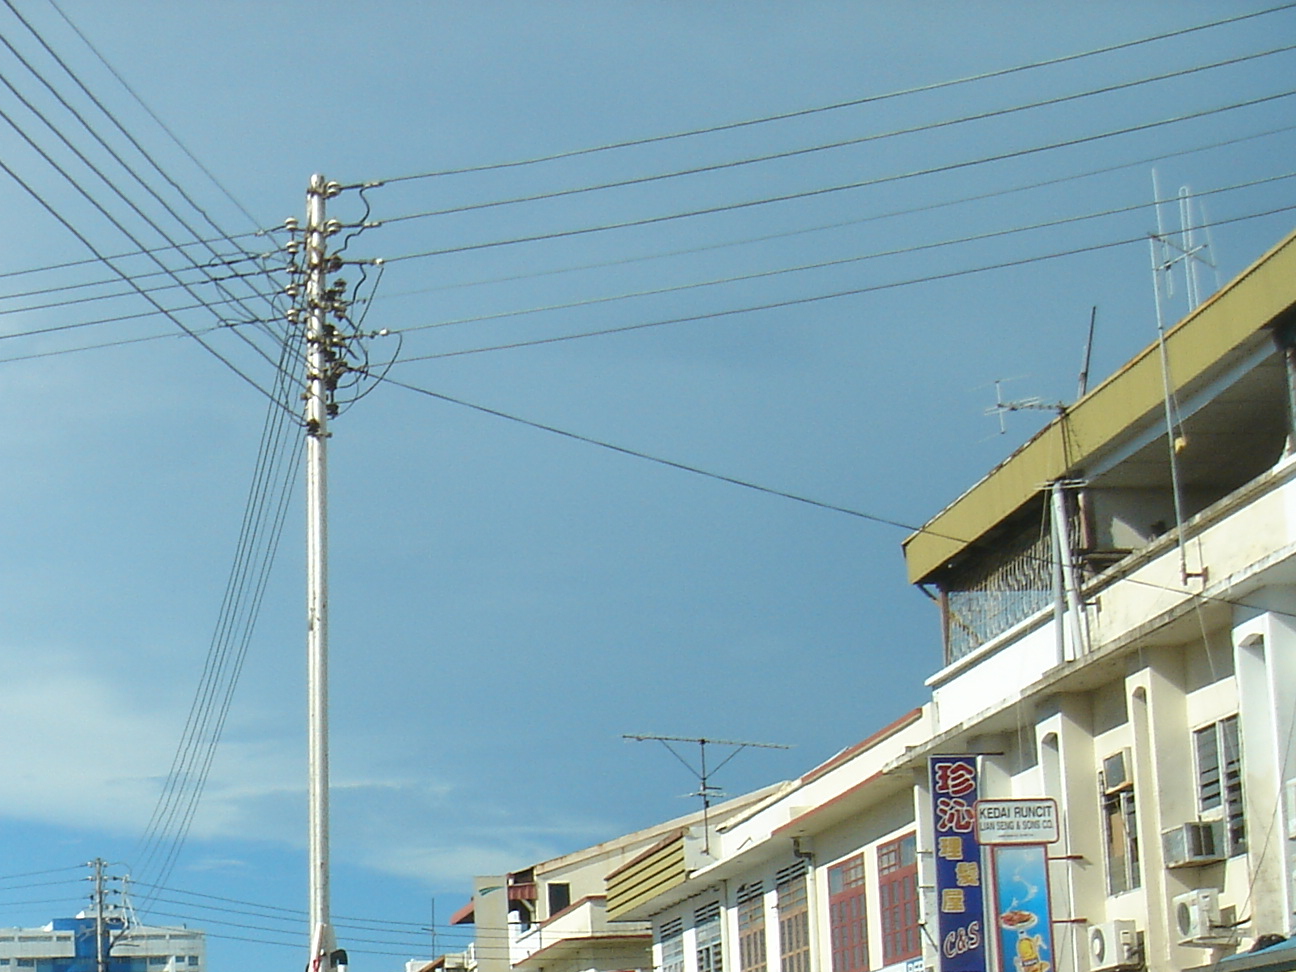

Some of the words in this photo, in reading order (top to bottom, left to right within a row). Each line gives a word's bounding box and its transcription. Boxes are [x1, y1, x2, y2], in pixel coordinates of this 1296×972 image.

[979, 806, 1011, 820] KEDAI
[1014, 805, 1053, 818] RUNCIT
[979, 821, 995, 832] LIAN
[996, 820, 1015, 831] SENG
[1016, 820, 1021, 831] &
[1022, 819, 1041, 830] SONS
[944, 920, 980, 960] C&S
